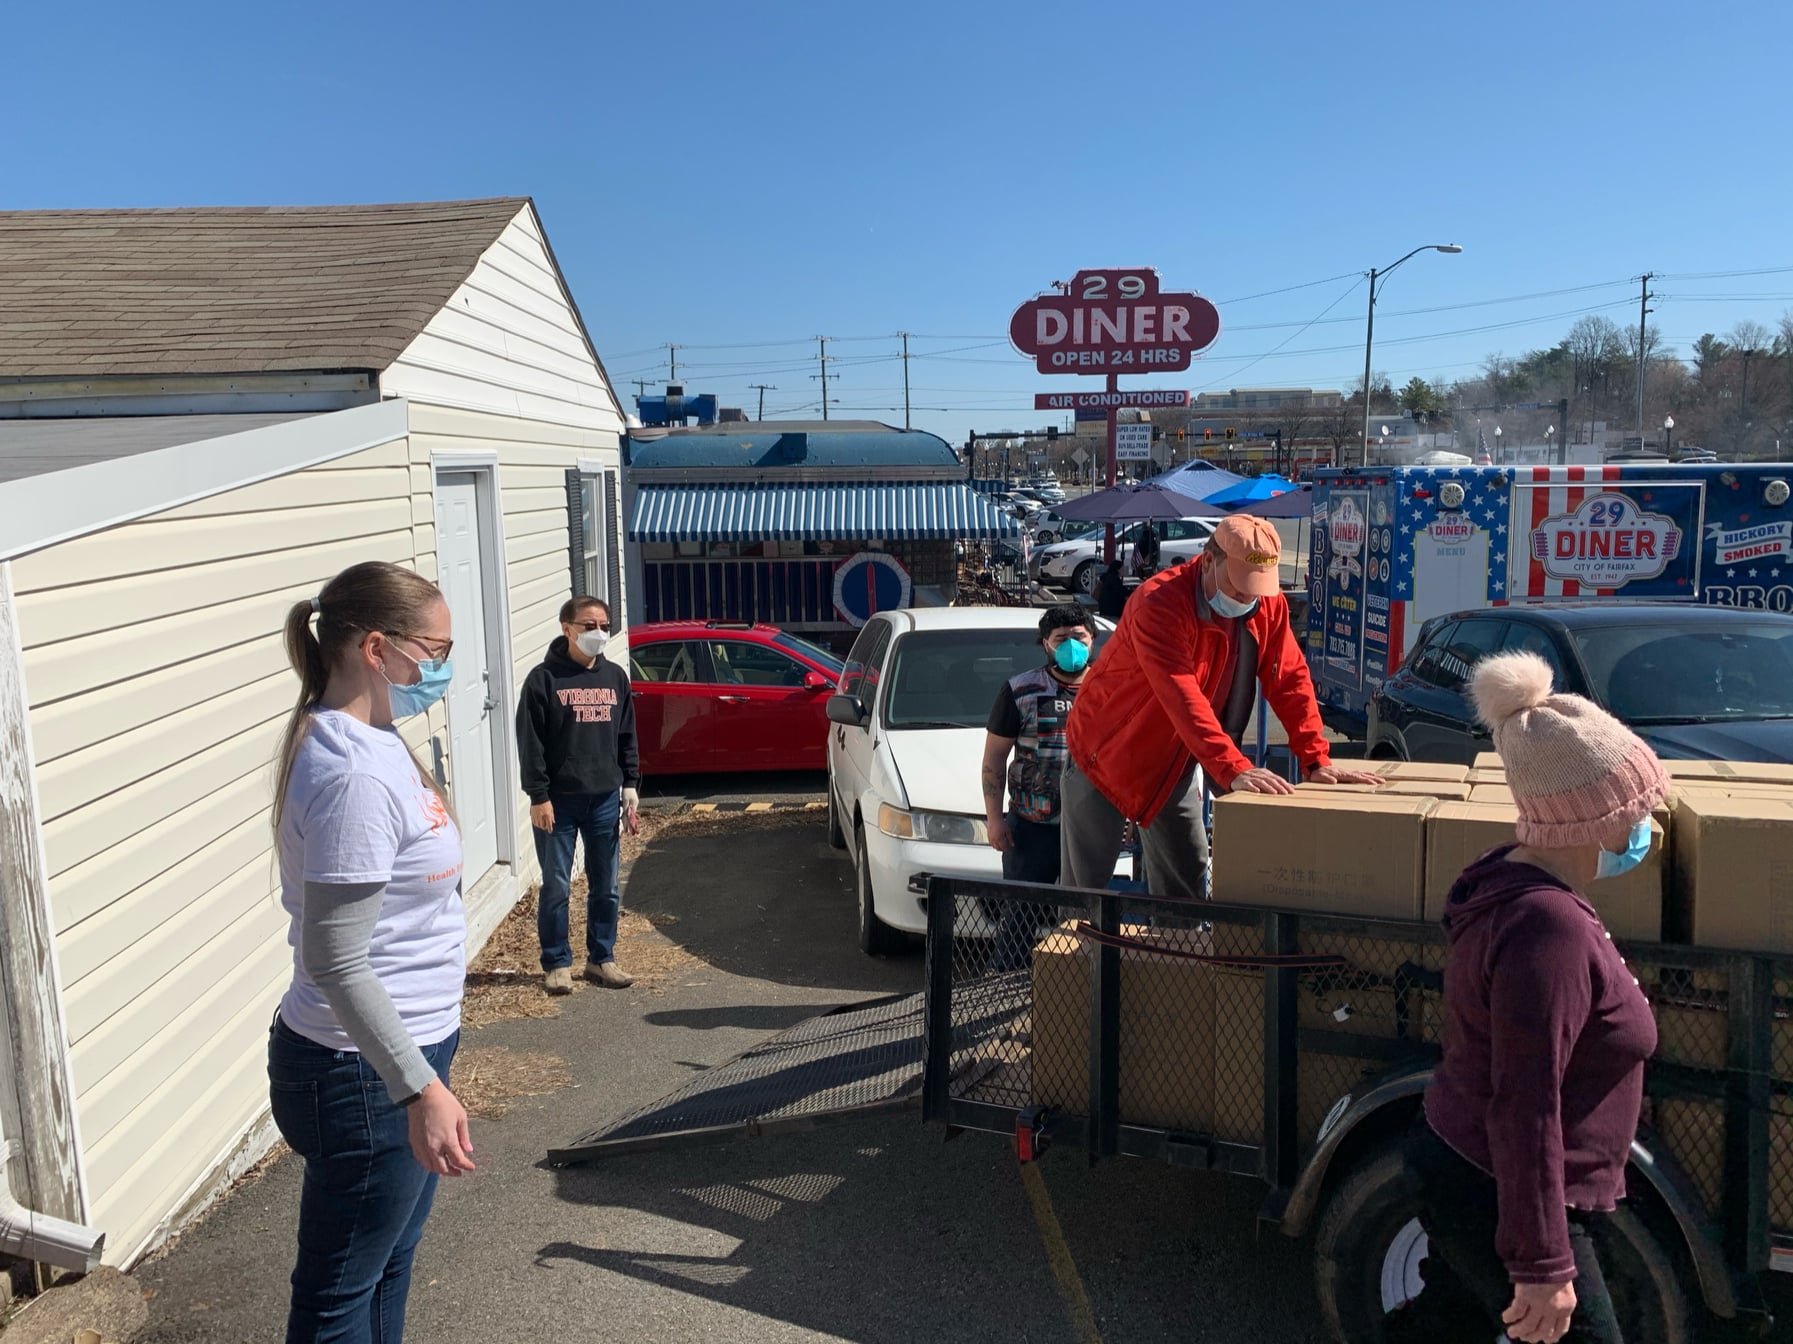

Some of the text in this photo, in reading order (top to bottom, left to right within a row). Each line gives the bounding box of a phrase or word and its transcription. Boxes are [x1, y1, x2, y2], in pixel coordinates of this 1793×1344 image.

[1082, 276, 1146, 300] 29
[1036, 305, 1192, 345] DINER
[1051, 348, 1181, 366] OPEN 24 HRS
[1048, 392, 1185, 407] AIR CONDITIONED
[1342, 504, 1352, 520] 29
[1446, 516, 1458, 525] 29
[1589, 501, 1625, 528] 29
[1334, 522, 1358, 542] DINER
[1435, 525, 1468, 536] DINER
[1724, 524, 1785, 544] HICKORY
[1436, 547, 1466, 556] MENU
[1555, 530, 1657, 560] DINER
[1723, 542, 1782, 562] SMOKED
[1312, 528, 1325, 613] BBQ
[1573, 563, 1636, 571] CITY OF FAIRFAX
[1367, 612, 1387, 627] SUICIDE
[557, 688, 617, 706] VIRGINIA
[573, 705, 612, 722] TECH
[427, 867, 456, 884] Health
